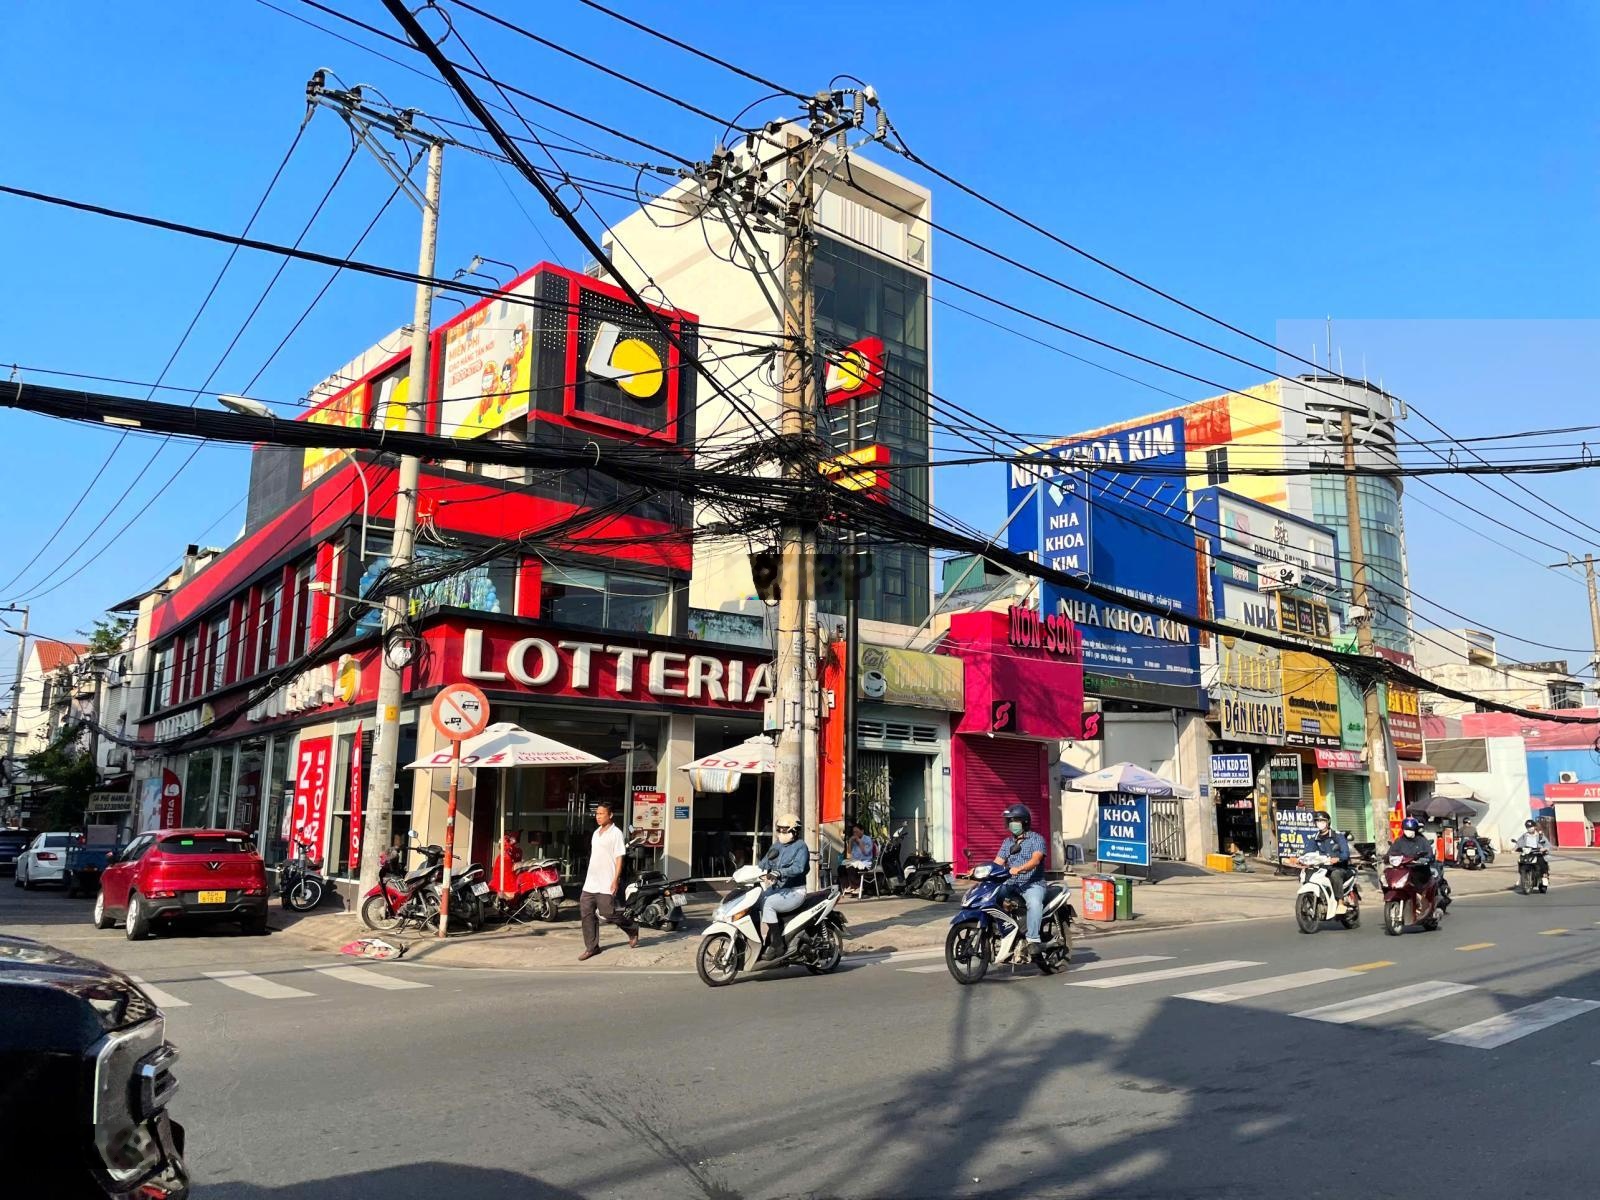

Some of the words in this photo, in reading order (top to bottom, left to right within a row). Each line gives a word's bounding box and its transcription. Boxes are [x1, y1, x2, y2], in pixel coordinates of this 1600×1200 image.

[1128, 424, 1175, 463] KIM
[1050, 512, 1079, 530] NHA
[1046, 532, 1085, 552] KHOA
[1053, 554, 1078, 571] KIM
[1060, 597, 1100, 626] NHA
[1104, 607, 1156, 637] KHOA
[1160, 618, 1190, 643] KIM
[462, 628, 774, 704] LOTTERIA
[1248, 702, 1268, 733] KEO
[1269, 705, 1283, 735] XE
[1213, 756, 1226, 771] DÁN
[1226, 759, 1239, 771] KEO
[1240, 759, 1248, 771] XE
[1280, 758, 1290, 767] KEO
[1290, 757, 1297, 767] XE
[1109, 794, 1136, 806] NHA
[1584, 787, 1600, 797] AT
[1103, 808, 1141, 823] KHOA
[1276, 809, 1295, 821] DÁN
[1296, 812, 1313, 822] KEO
[1110, 825, 1135, 838] KIM
